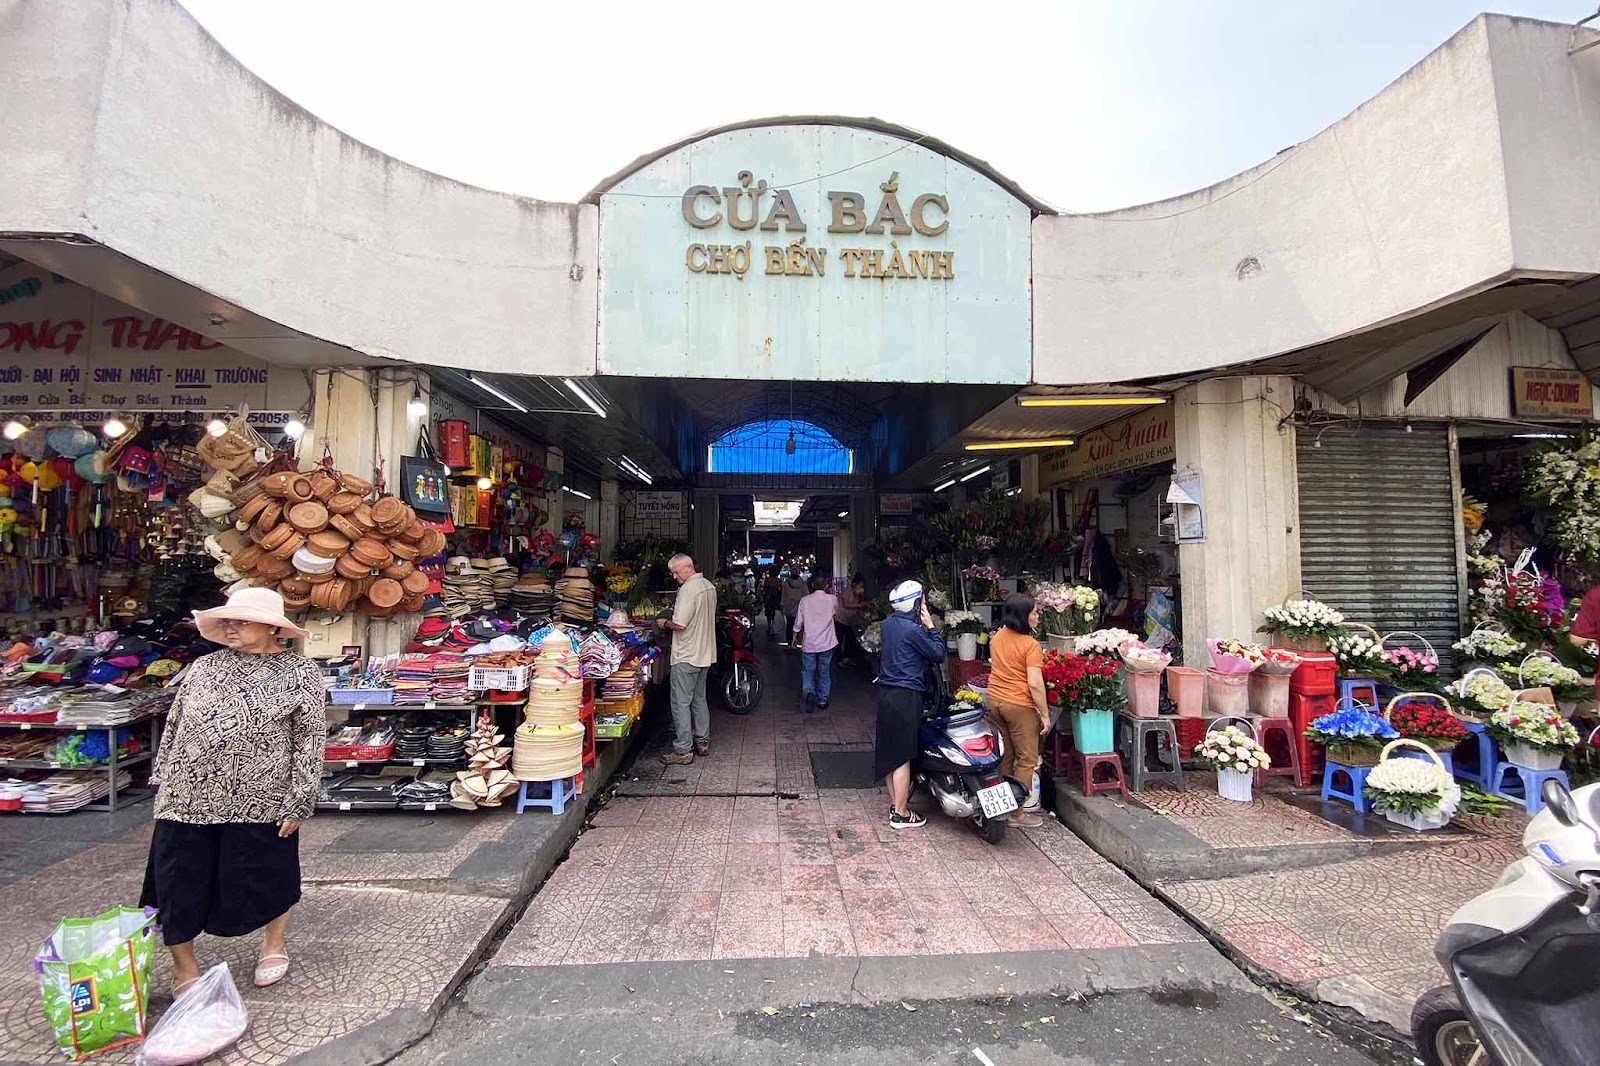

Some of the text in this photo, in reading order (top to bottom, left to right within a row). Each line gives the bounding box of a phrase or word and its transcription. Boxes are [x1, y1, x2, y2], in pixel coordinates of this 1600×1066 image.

[681, 170, 950, 236] CỬA BẮC
[685, 236, 955, 280] CHỢ BẾN THÀNH
[93, 368, 122, 383] SINH
[130, 365, 163, 386] NHẬT
[175, 368, 206, 383] KHAI
[171, 394, 207, 405] Thành
[1157, 445, 1174, 457] HOA
[984, 797, 1015, 816] 831.54
[73, 998, 91, 1007] LDI
